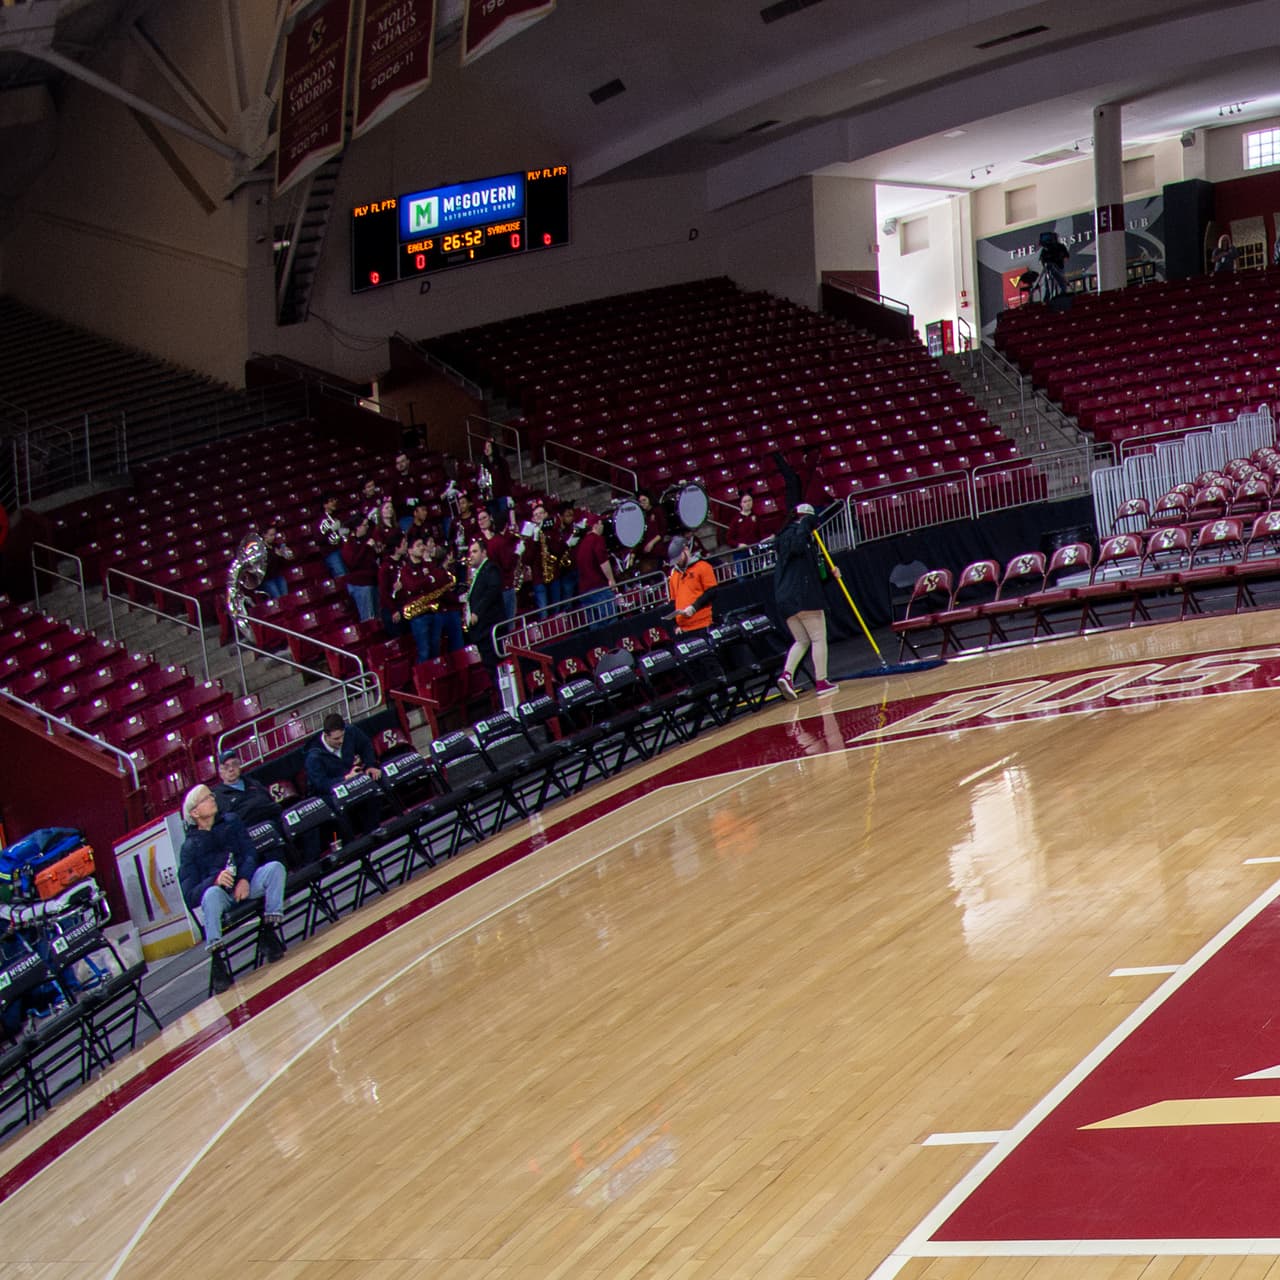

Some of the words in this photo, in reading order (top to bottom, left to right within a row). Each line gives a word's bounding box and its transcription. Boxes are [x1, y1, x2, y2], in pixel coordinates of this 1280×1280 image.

[377, 0, 414, 35] MOLLY
[370, 12, 417, 55] SCHAUS
[289, 57, 337, 101] CAROLYN
[371, 51, 415, 91] 2006-11
[290, 74, 334, 116] SWORDS
[553, 166, 567, 176] PTS
[381, 199, 396, 211] PTS
[415, 201, 432, 227] M
[487, 221, 521, 236] SYRACUSE
[408, 240, 433, 254] EAGLES
[443, 230, 482, 251] 26:52
[510, 233, 520, 248] 0
[415, 253, 426, 270] 0
[1008, 244, 1036, 260] THE
